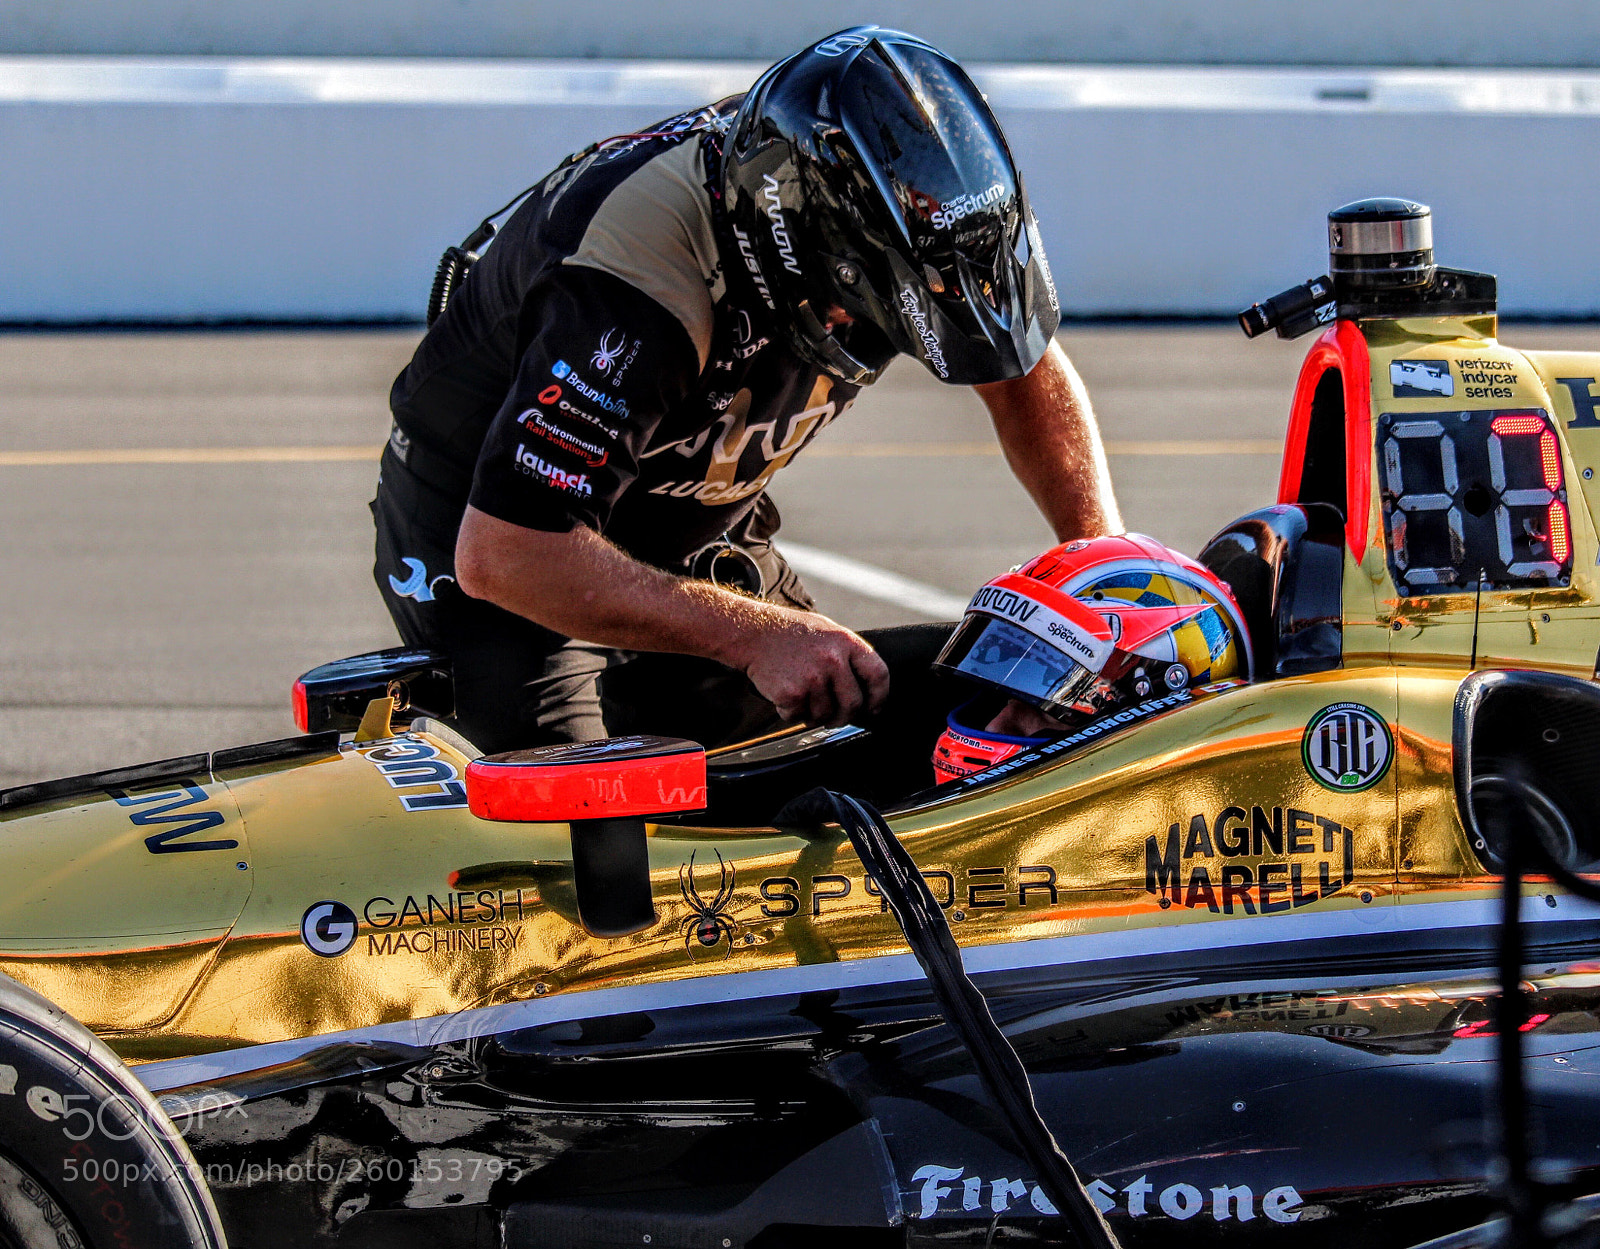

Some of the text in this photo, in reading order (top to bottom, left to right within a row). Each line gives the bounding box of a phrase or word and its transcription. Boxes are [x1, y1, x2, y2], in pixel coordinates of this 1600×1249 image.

[931, 184, 1001, 230] Spectrum
[940, 194, 967, 212] Charter
[1461, 371, 1518, 386] indycar
[1465, 386, 1513, 398] series
[525, 421, 593, 460] Rail Solutions
[536, 416, 605, 456] Environmental
[515, 443, 592, 495] launch
[1048, 622, 1093, 657] Spectrum
[963, 753, 1042, 786] JAMES
[363, 889, 523, 929] GANESH
[368, 926, 522, 956] MACHINERY
